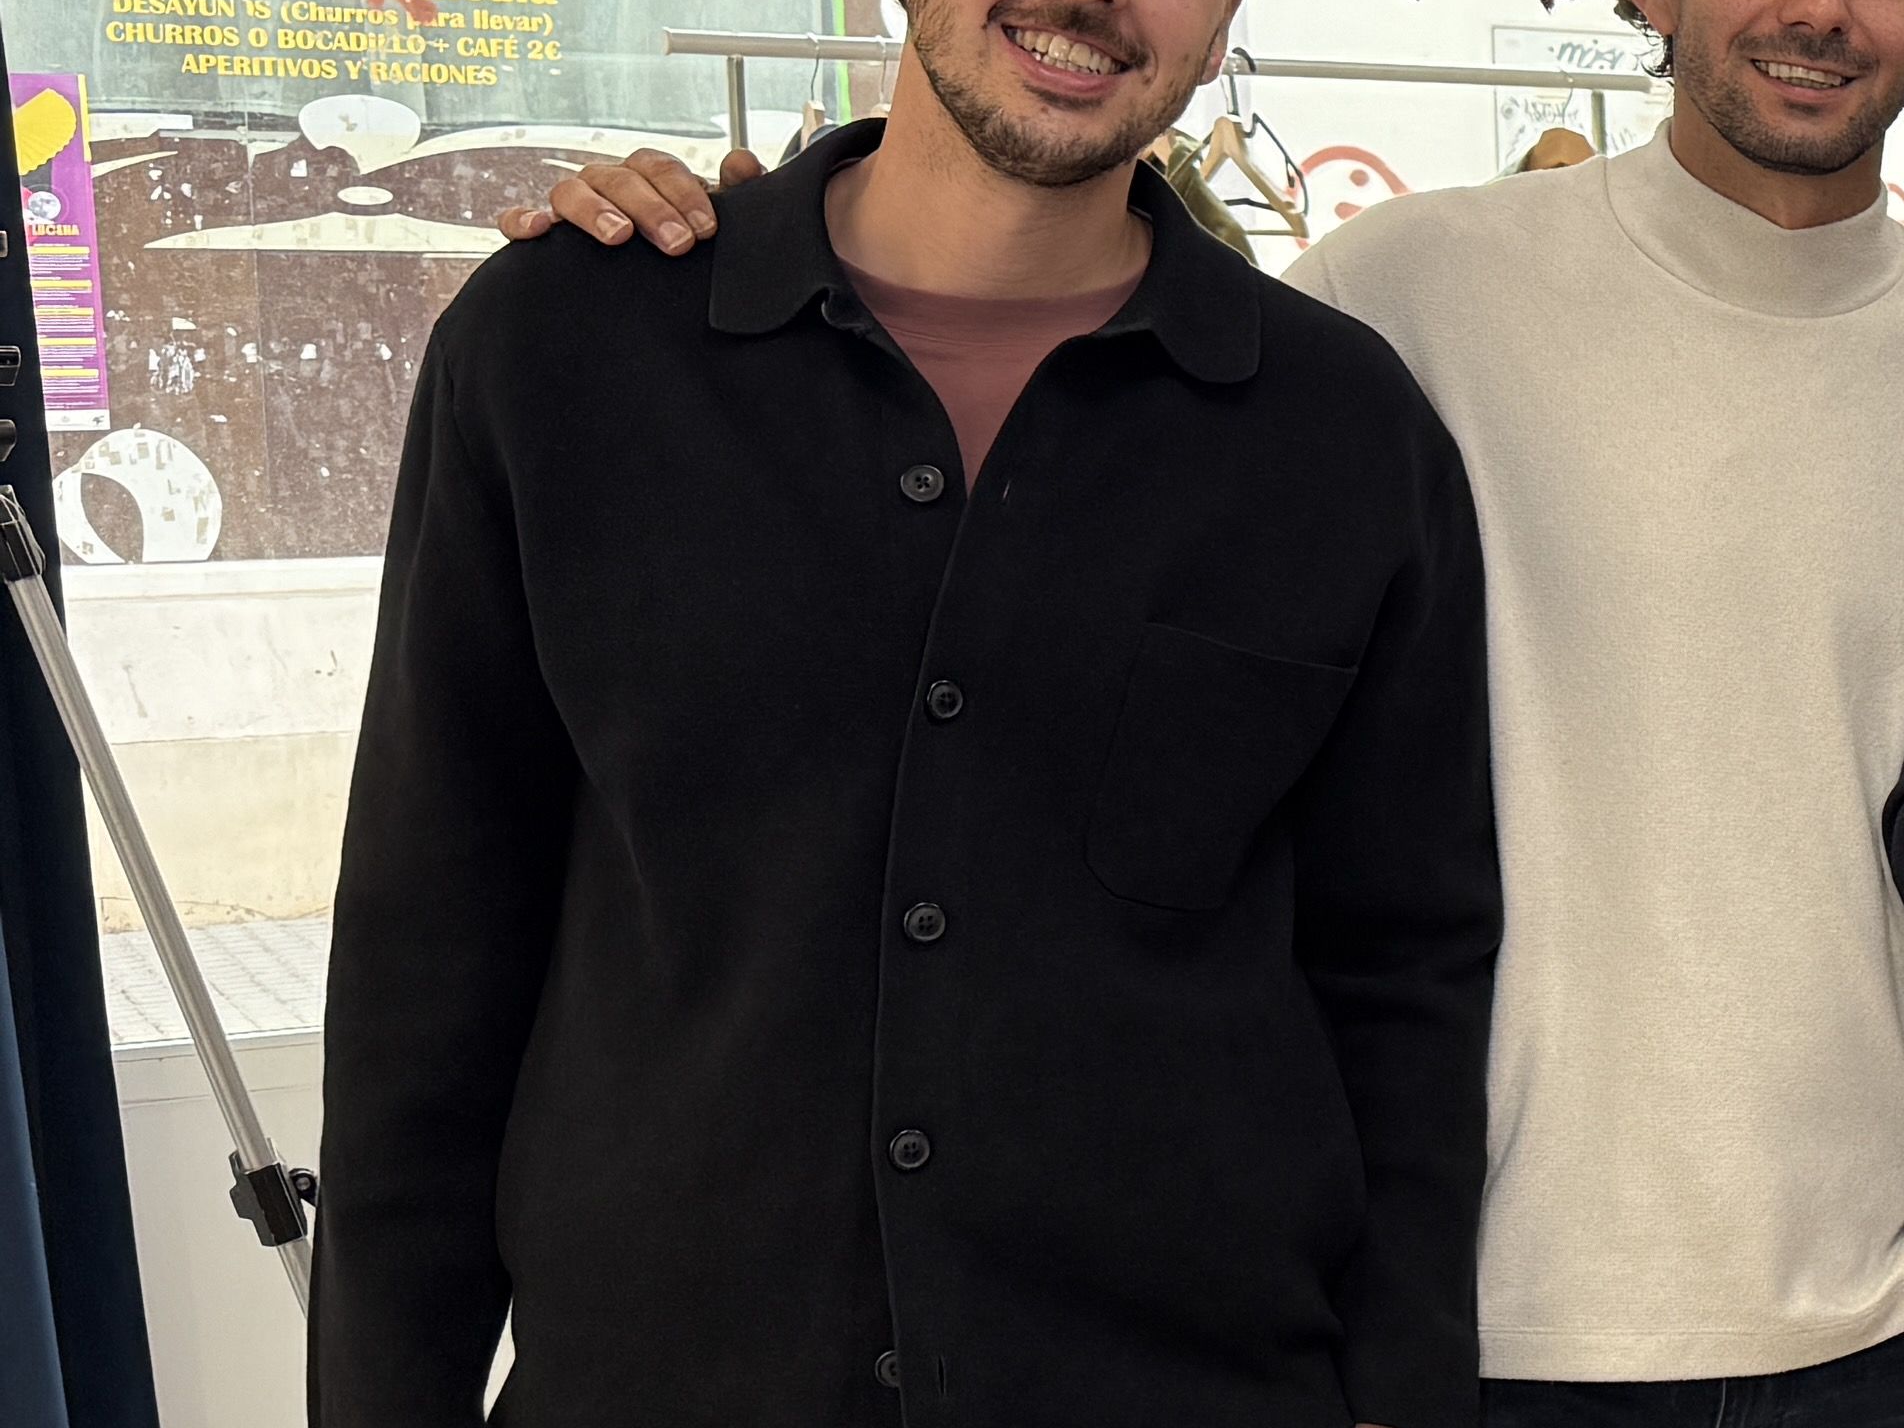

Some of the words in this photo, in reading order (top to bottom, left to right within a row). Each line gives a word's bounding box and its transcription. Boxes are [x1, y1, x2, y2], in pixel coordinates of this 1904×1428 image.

[281, 0, 399, 25] (Churros
[473, 8, 555, 37] llevar)
[105, 21, 241, 47] CHURROS
[248, 26, 269, 48] O
[277, 28, 426, 55] BOCADILLO
[456, 34, 520, 59] CAFÉ
[527, 39, 562, 61] 2€
[181, 53, 338, 79] APERITIVOS
[344, 59, 363, 80] Y
[370, 61, 498, 86] RACIONES
